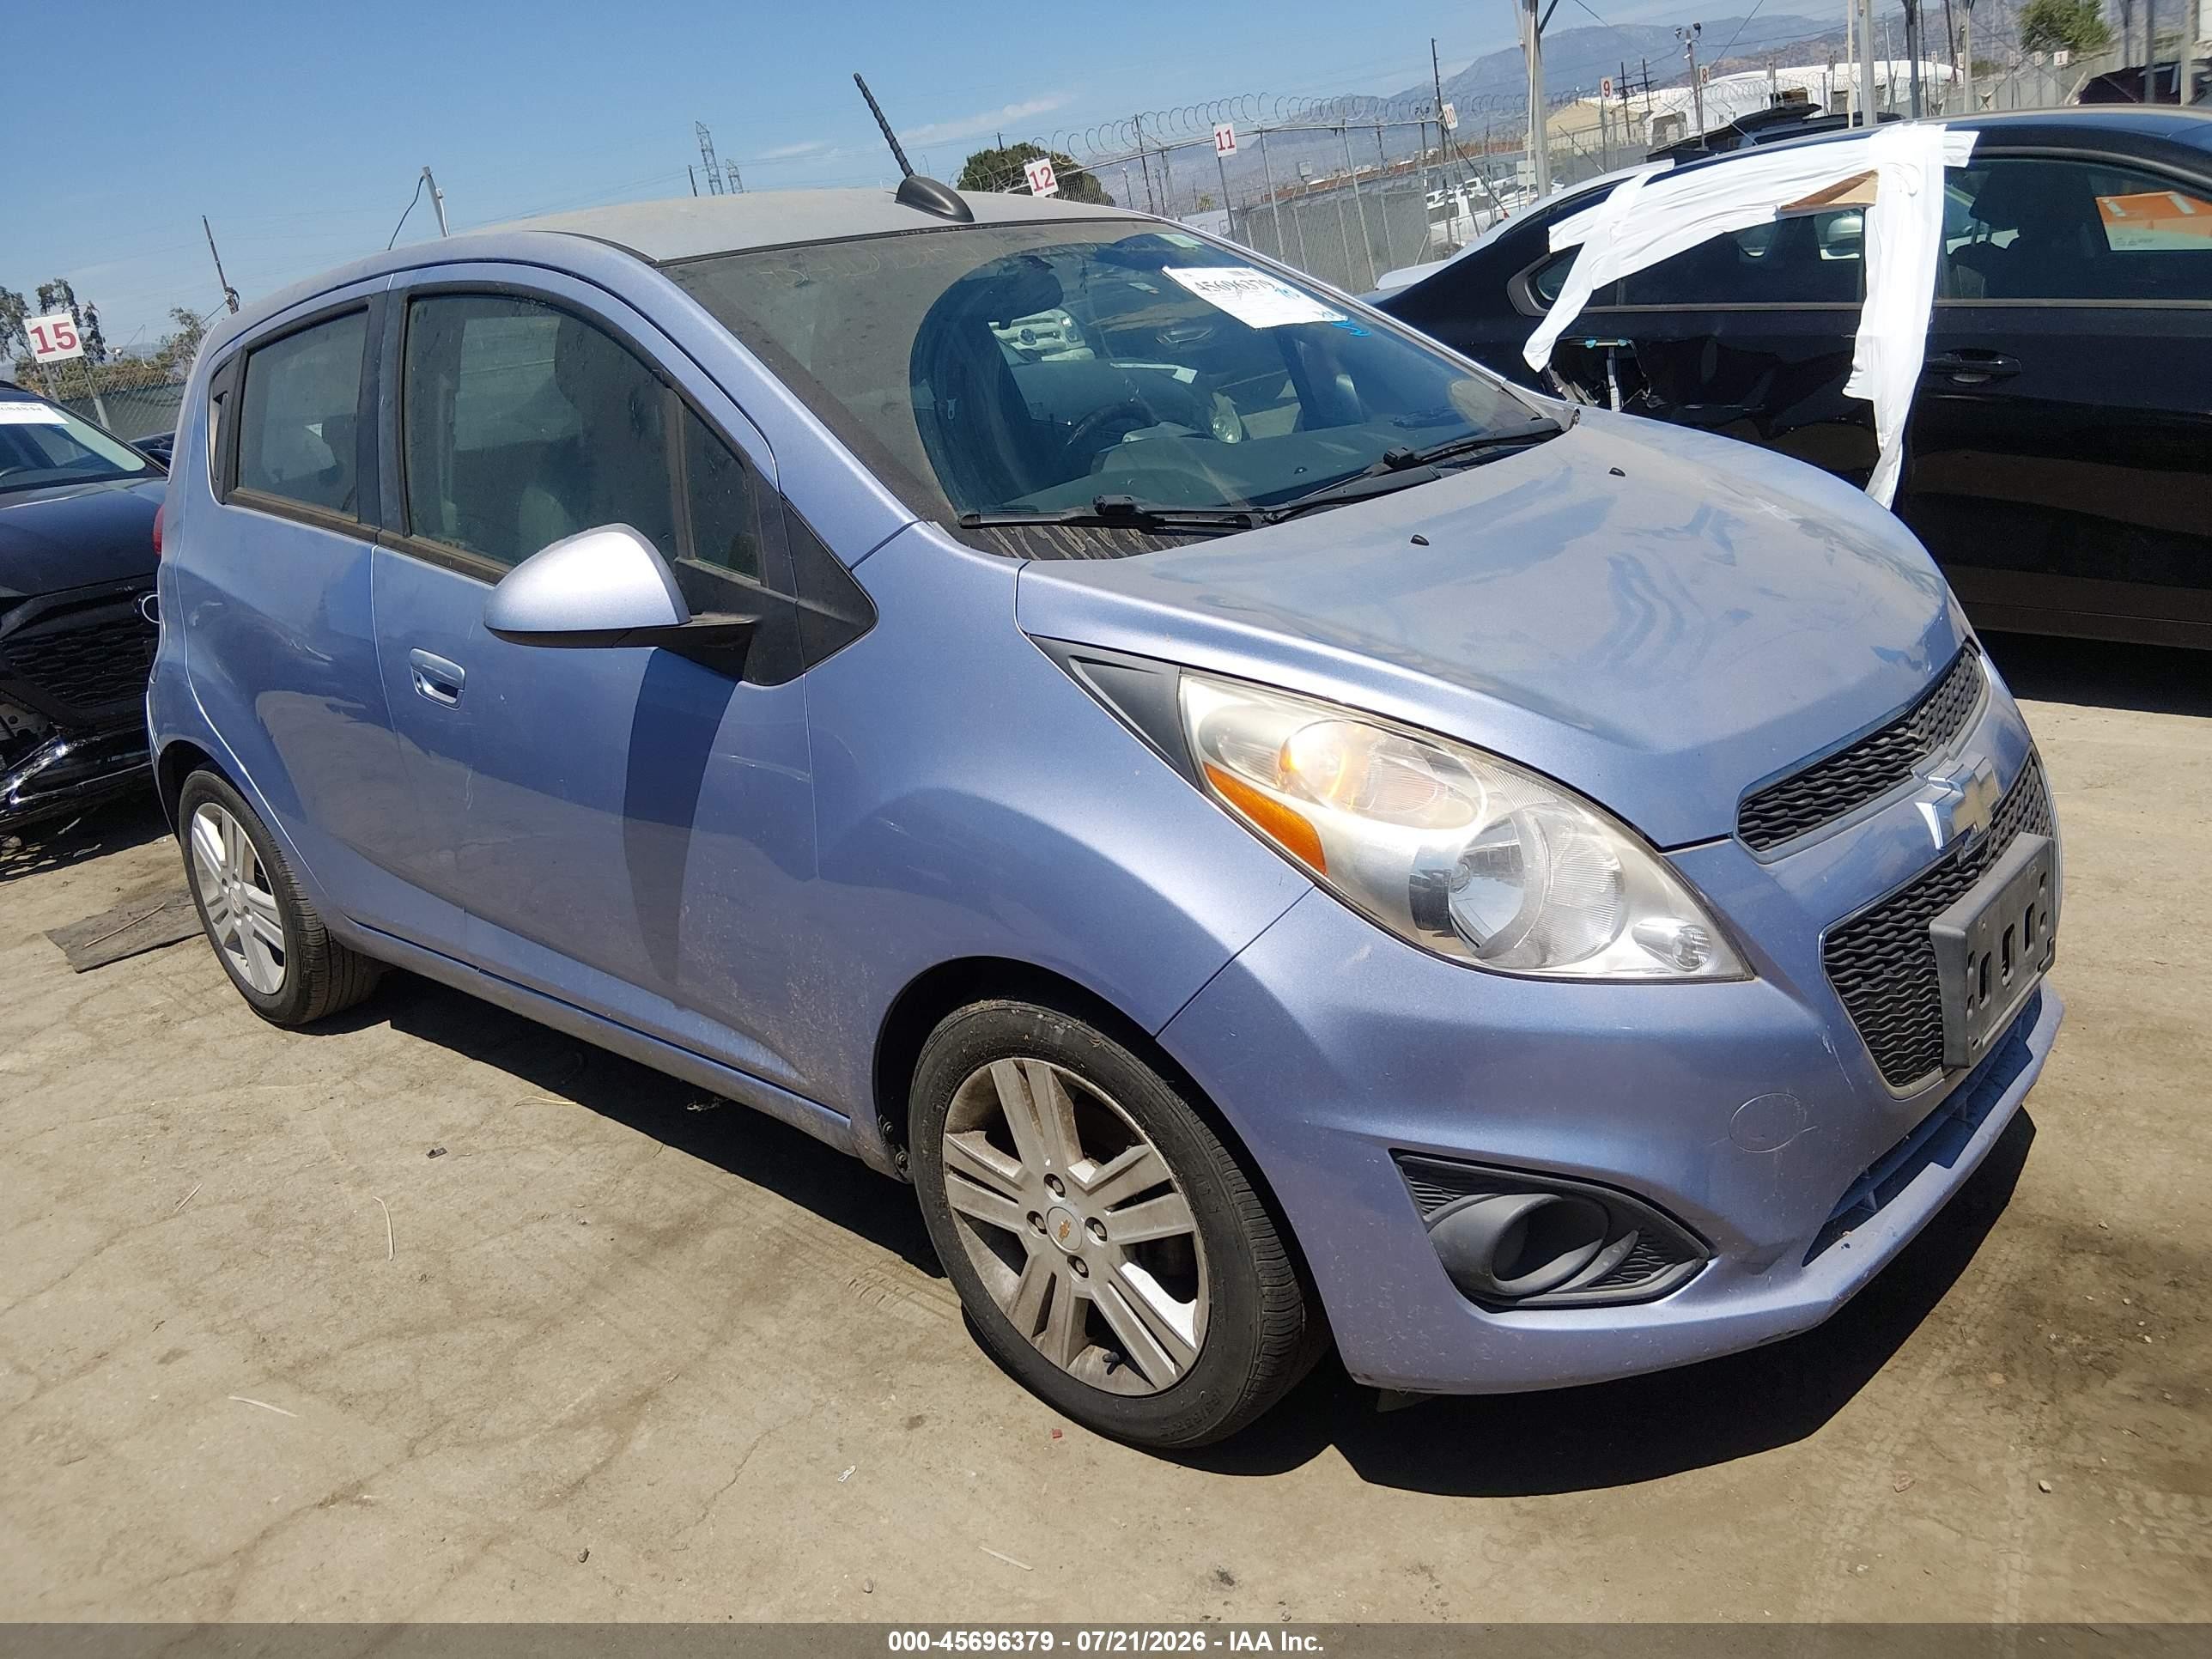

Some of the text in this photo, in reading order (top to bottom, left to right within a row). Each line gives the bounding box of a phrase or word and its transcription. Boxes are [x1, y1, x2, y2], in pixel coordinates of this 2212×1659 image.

[1702, 68, 1708, 84] 8
[1603, 81, 1611, 98] 9
[1445, 108, 1455, 125] 10
[1215, 129, 1236, 151] 11
[1029, 166, 1055, 192] 12
[30, 321, 77, 354] 15
